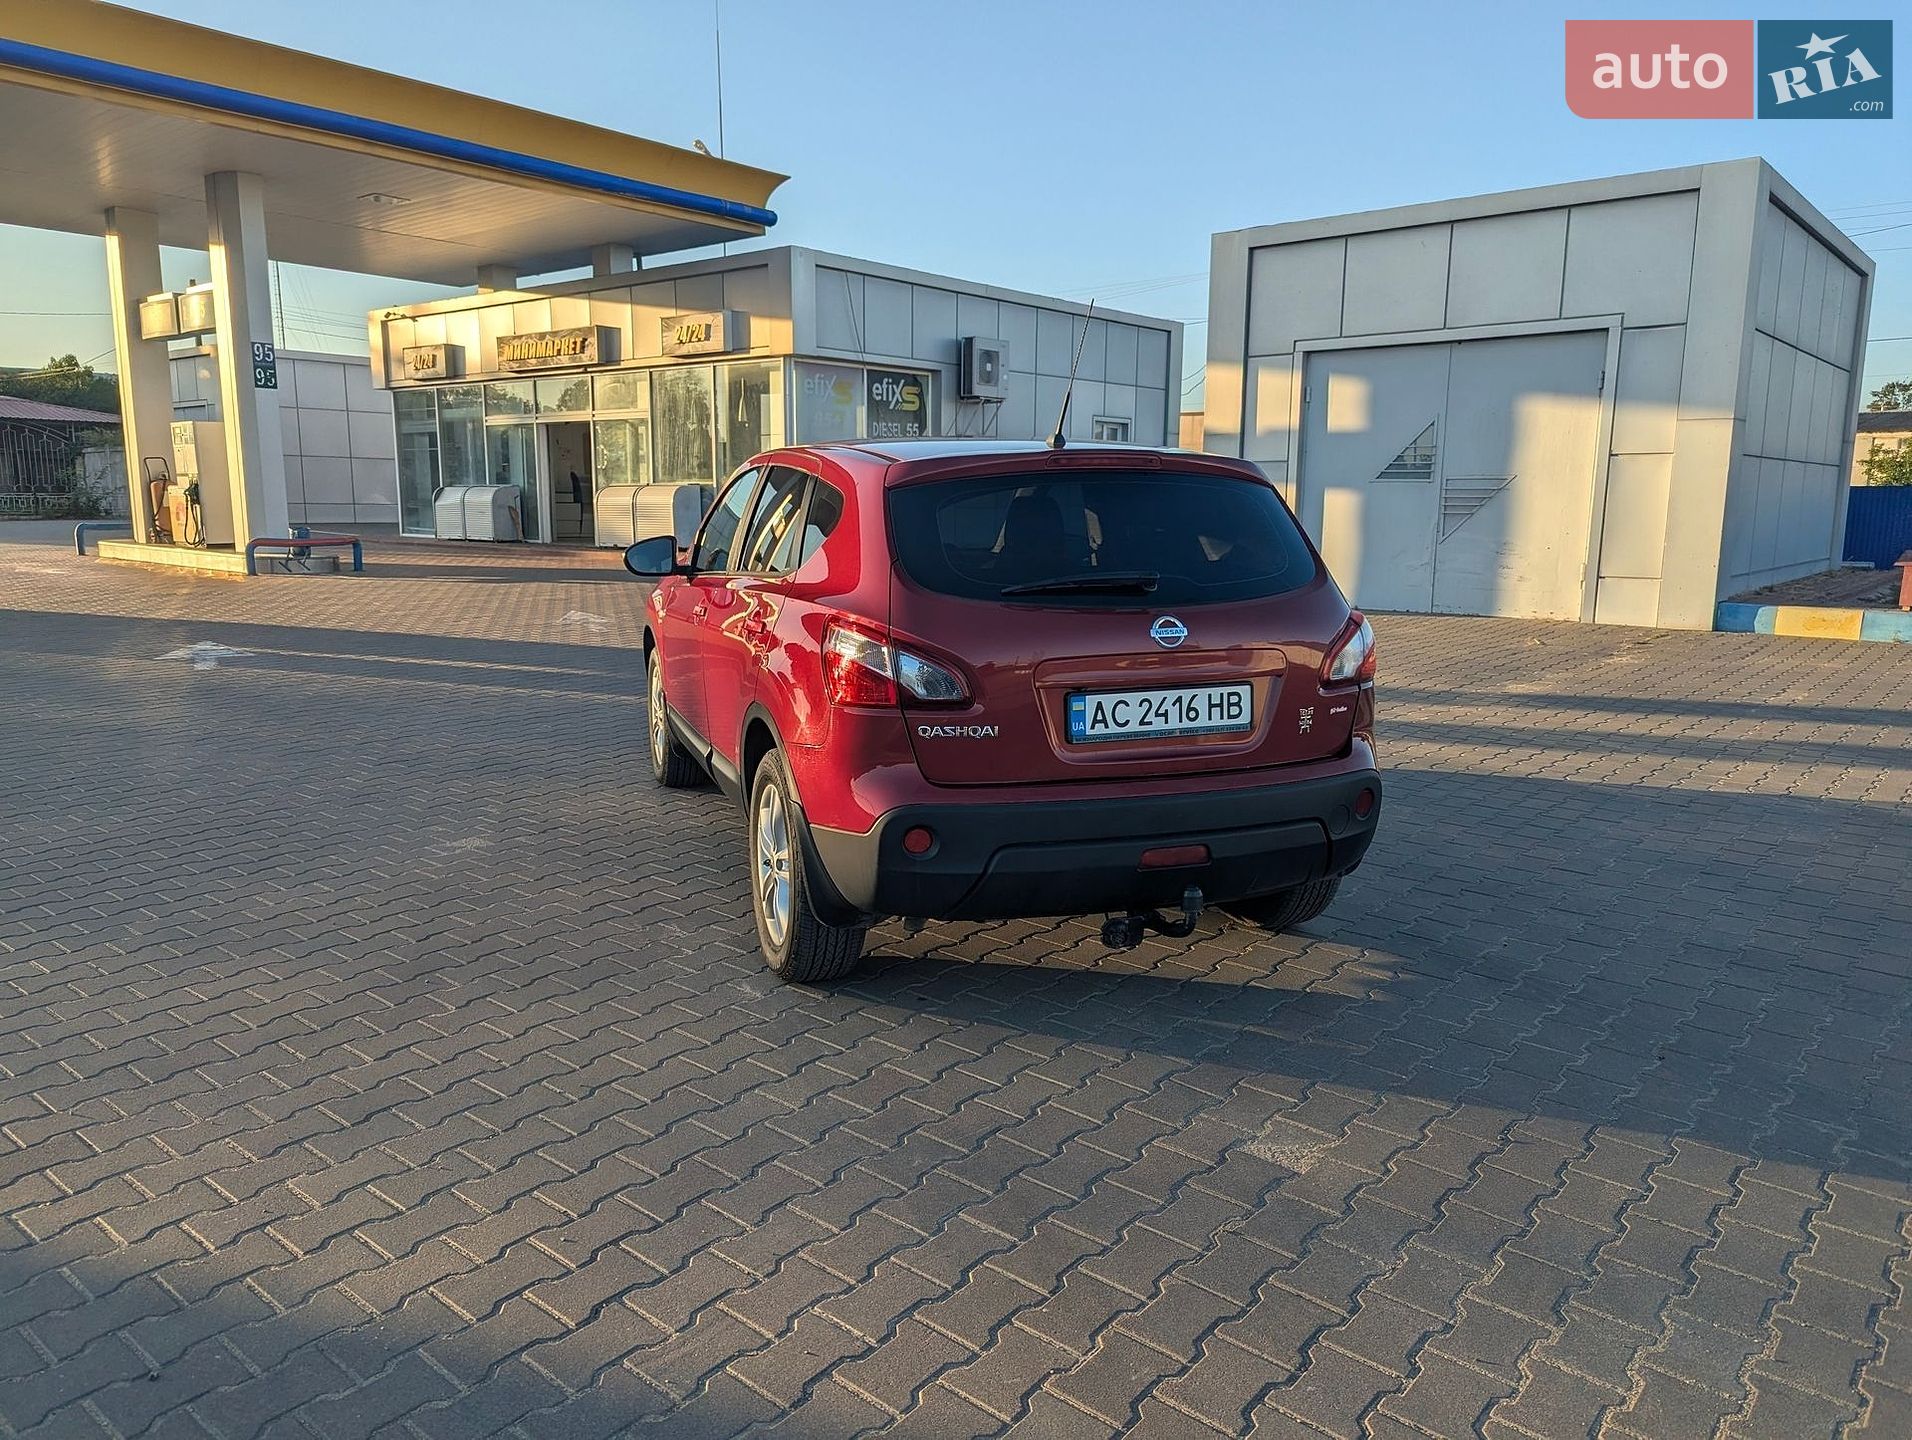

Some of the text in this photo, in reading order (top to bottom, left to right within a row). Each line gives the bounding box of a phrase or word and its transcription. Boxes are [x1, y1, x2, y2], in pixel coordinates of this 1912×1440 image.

[676, 324, 706, 344] 24/24
[254, 343, 274, 361] 95
[506, 336, 583, 361] МИНИМАРКЕТ
[872, 422, 901, 437] DIESEL
[1155, 628, 1185, 636] NISSAN
[1089, 691, 1243, 731] AC 2416 HB
[917, 725, 999, 739] QASHQAI
[1072, 722, 1085, 732] UA
